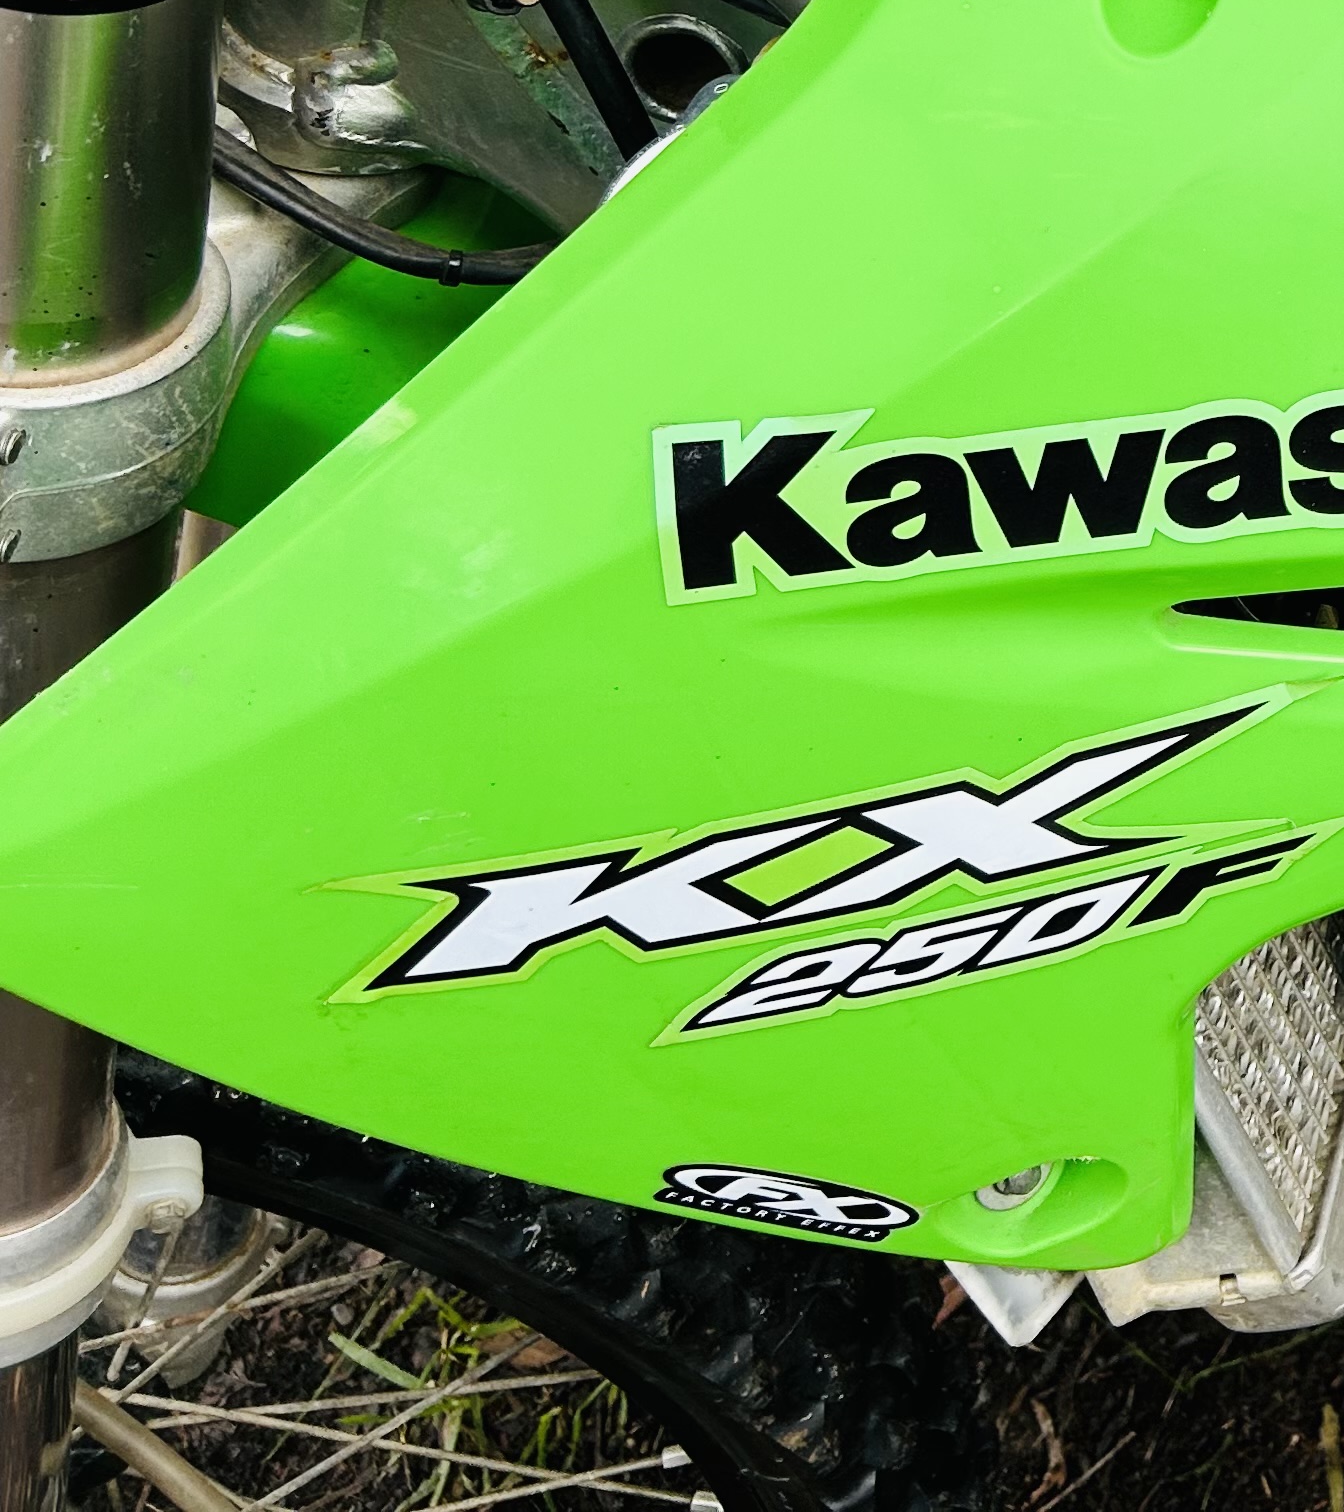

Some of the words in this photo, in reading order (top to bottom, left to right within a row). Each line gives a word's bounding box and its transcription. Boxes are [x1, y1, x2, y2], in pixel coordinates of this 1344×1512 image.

[366, 701, 1271, 991] KX
[680, 833, 1317, 1034] 250F
[664, 1190, 786, 1221] FACTORY
[800, 1218, 880, 1238] EFFEX
[712, 1177, 882, 1225] FX
